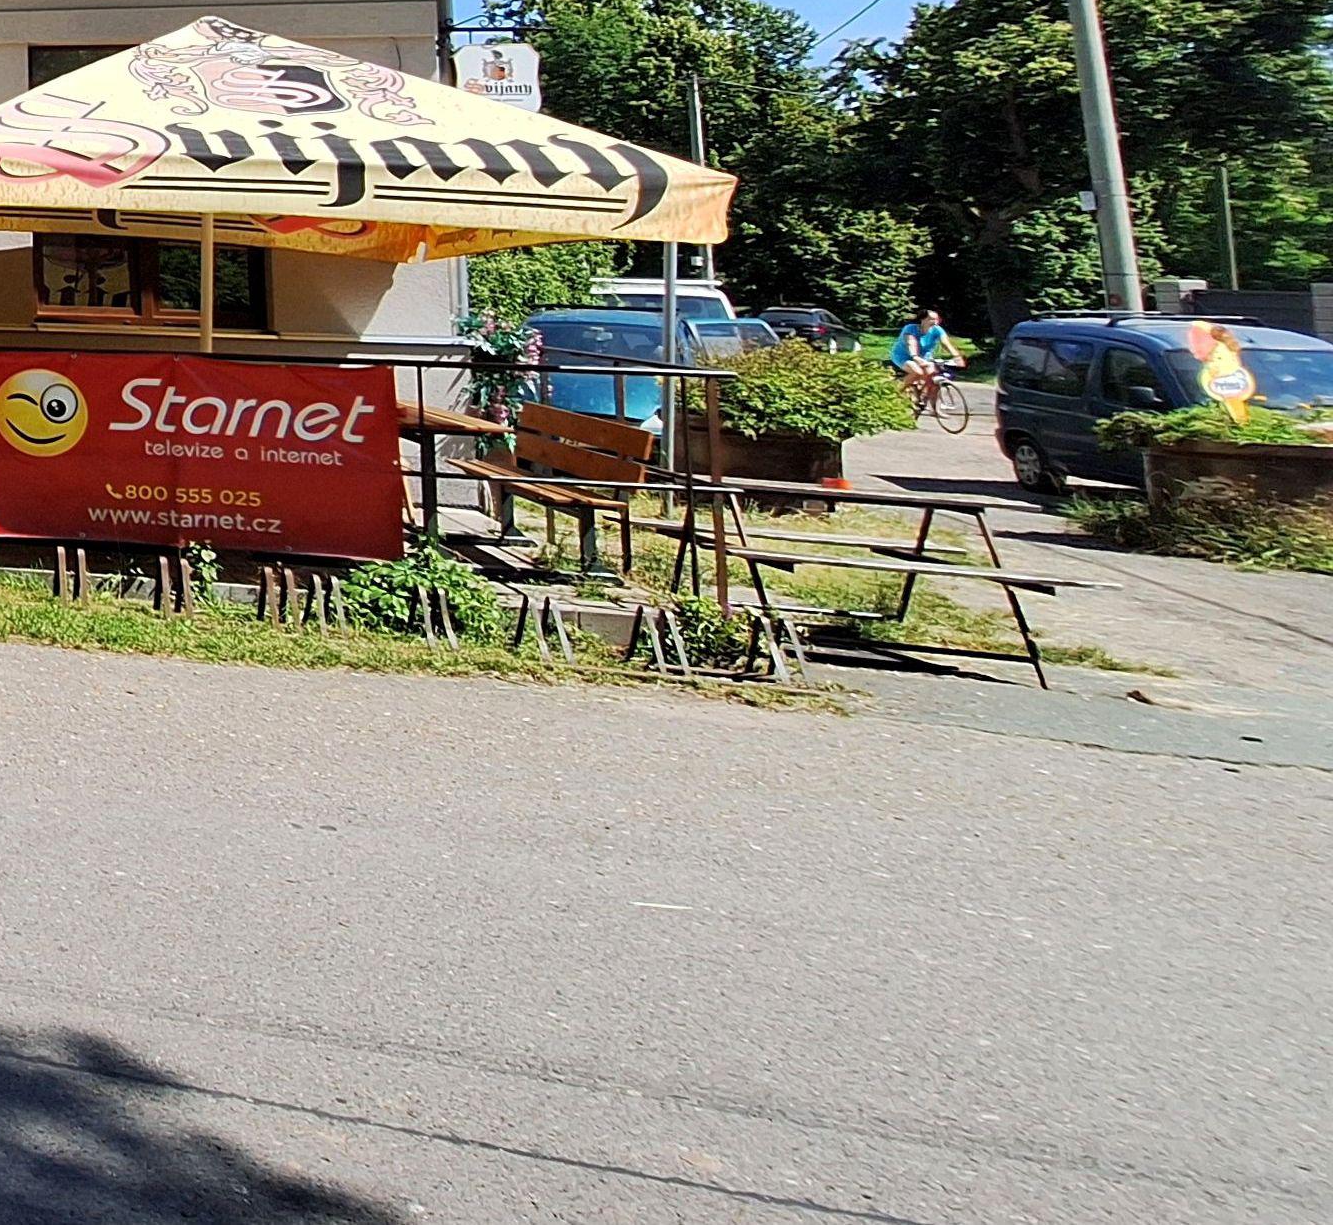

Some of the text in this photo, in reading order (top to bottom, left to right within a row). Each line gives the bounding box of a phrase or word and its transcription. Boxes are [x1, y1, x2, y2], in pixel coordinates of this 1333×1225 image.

[464, 78, 532, 95] Svijany
[108, 378, 376, 443] Starnet
[144, 439, 344, 467] televize a internet
[124, 484, 262, 508] 800 555 025
[87, 506, 282, 534] www.starnet.cz
